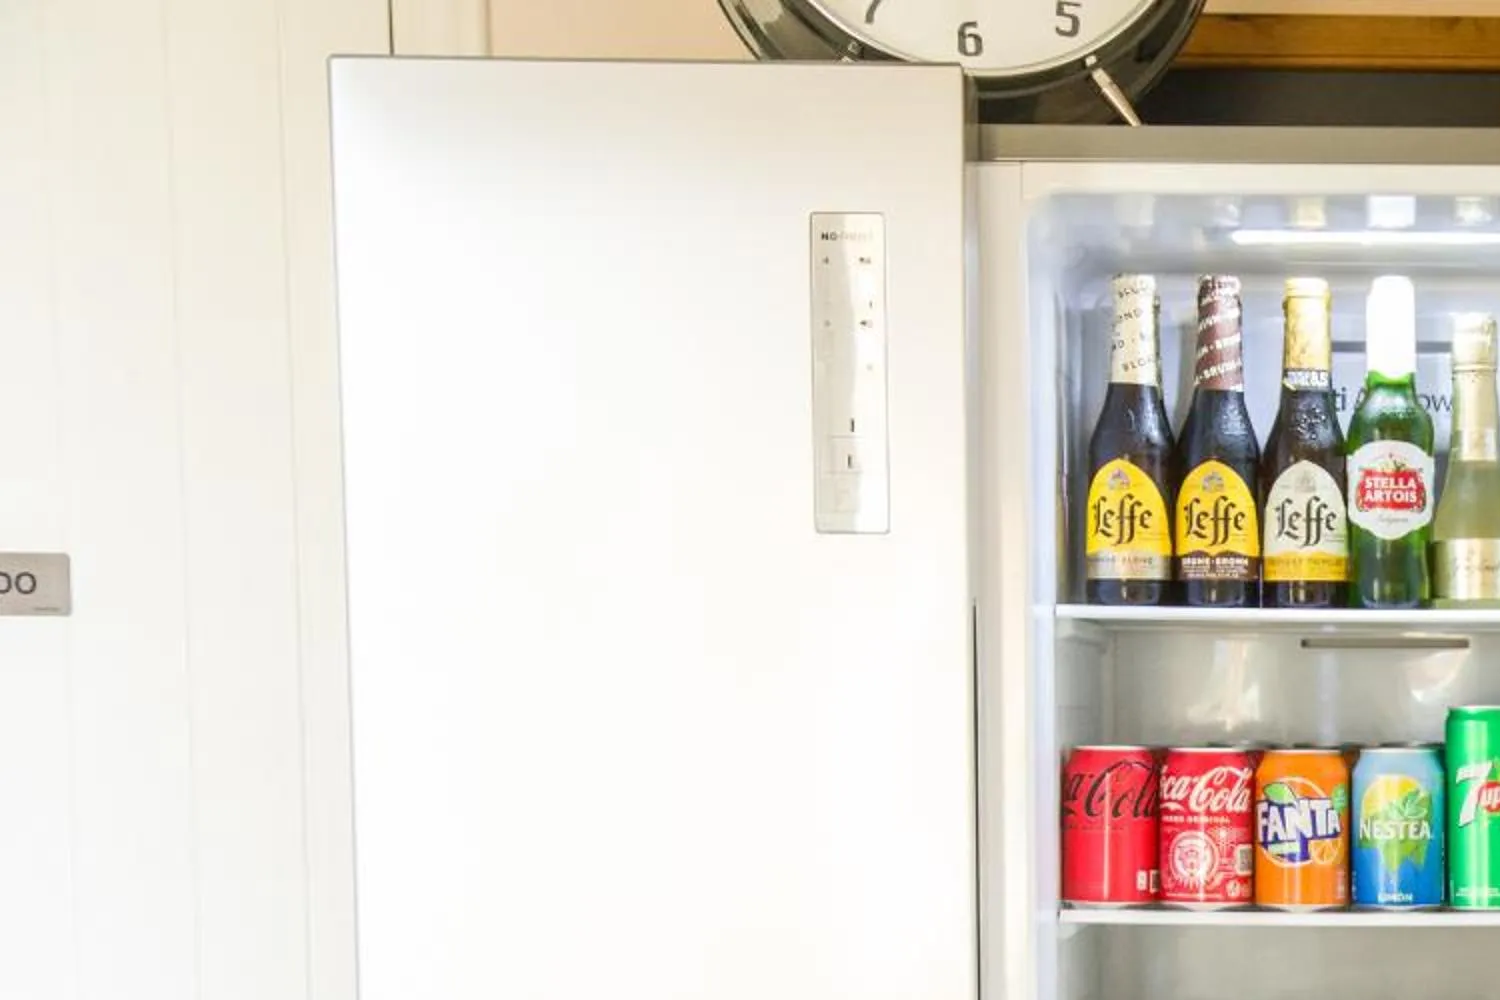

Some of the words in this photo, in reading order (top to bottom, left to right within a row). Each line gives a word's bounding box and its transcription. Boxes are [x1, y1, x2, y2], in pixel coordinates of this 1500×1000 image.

[1055, 2, 1081, 37] 5
[957, 21, 983, 56] 6
[1364, 476, 1416, 489] STELLA
[1364, 490, 1417, 503] ARTOIS
[1093, 493, 1153, 545] Leffe
[1185, 493, 1245, 545] Leffe
[1276, 495, 1337, 546] Leffe
[1257, 798, 1341, 843] FANTA
[1359, 820, 1433, 840] NESTEA
